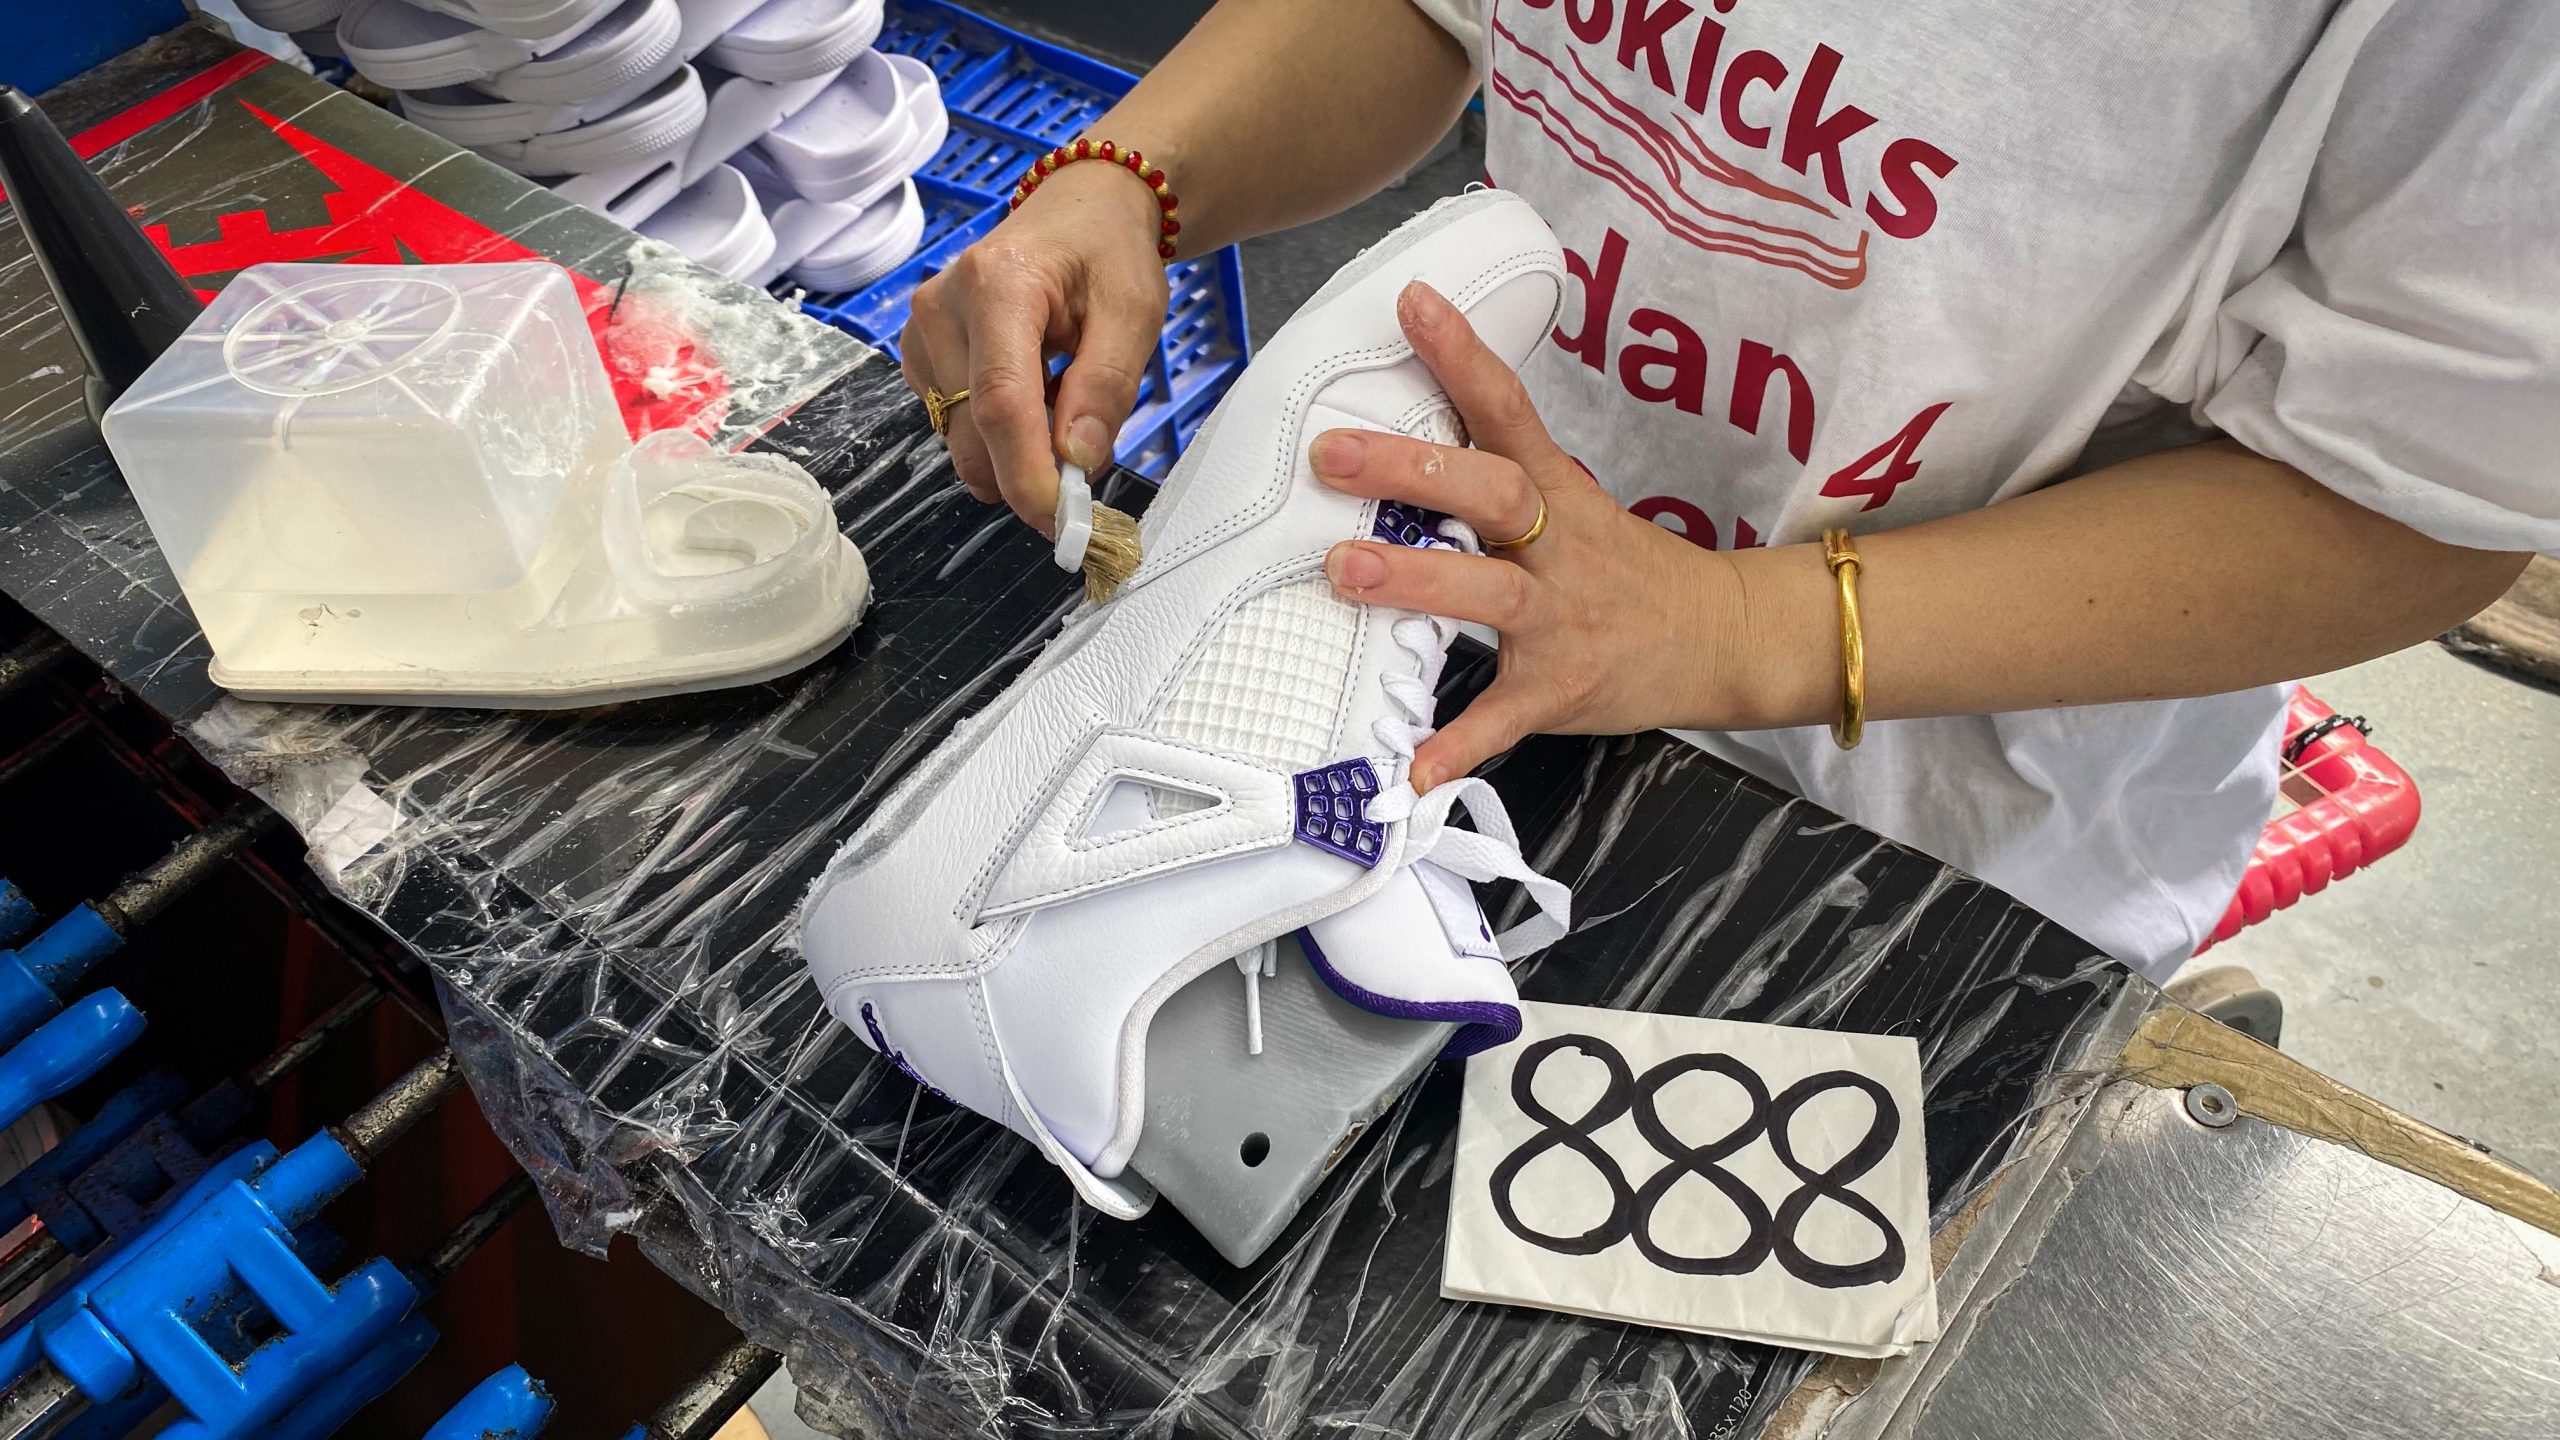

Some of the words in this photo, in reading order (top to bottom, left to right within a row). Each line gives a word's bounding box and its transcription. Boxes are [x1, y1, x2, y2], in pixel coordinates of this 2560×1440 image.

[1818, 401, 1954, 513] 4
[1489, 1033, 1906, 1289] 888
[1729, 1388, 1752, 1414] 120
